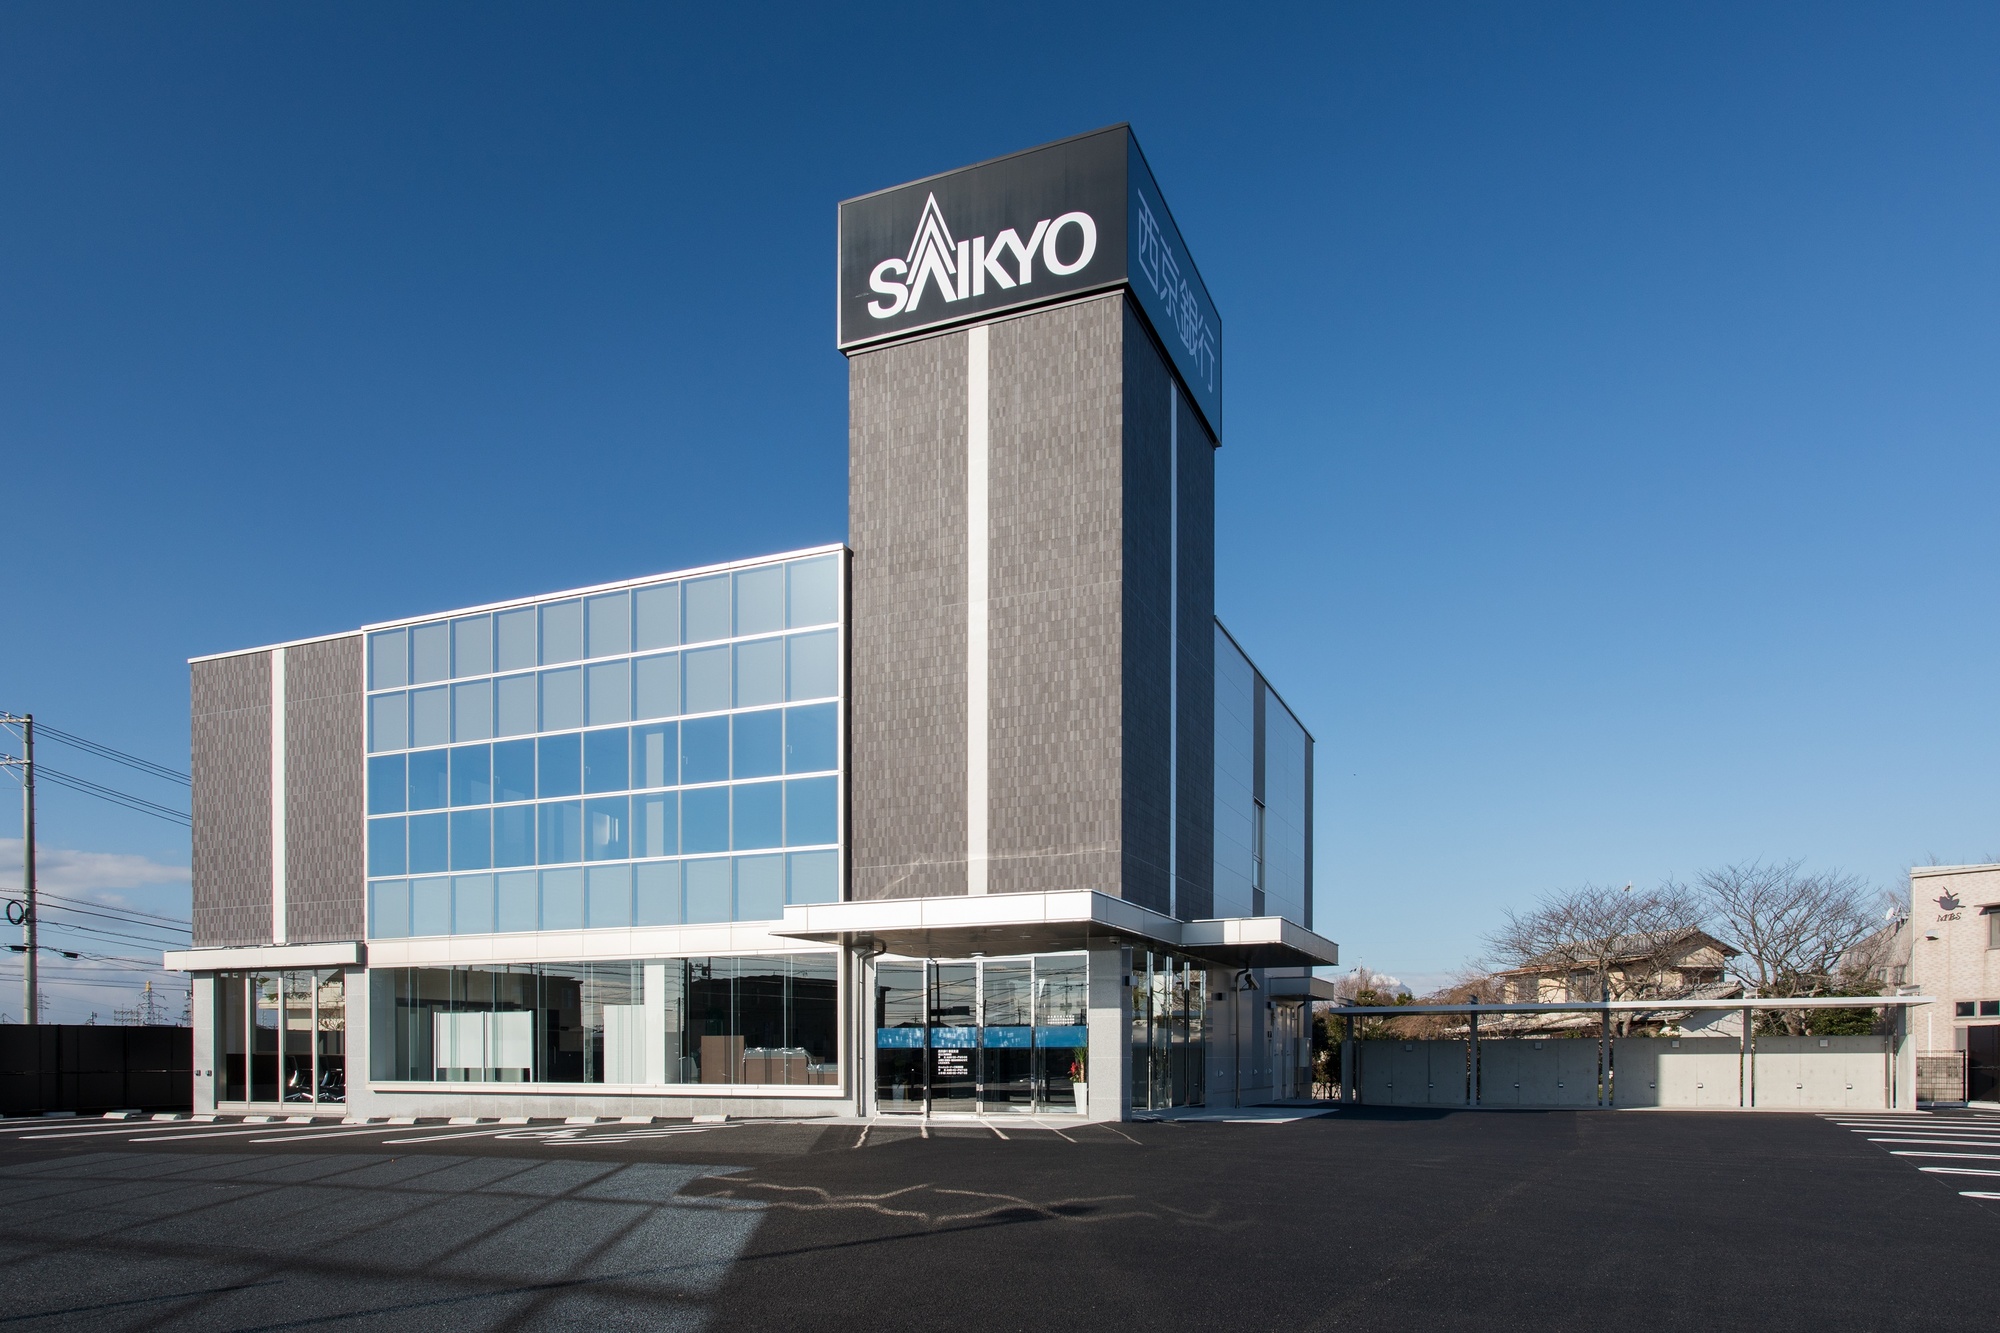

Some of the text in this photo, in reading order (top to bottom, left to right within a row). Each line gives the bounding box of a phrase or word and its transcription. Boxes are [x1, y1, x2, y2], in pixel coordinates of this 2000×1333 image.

[867, 191, 1097, 319] SAIKYO
[1138, 188, 1215, 393] 西京銀行
